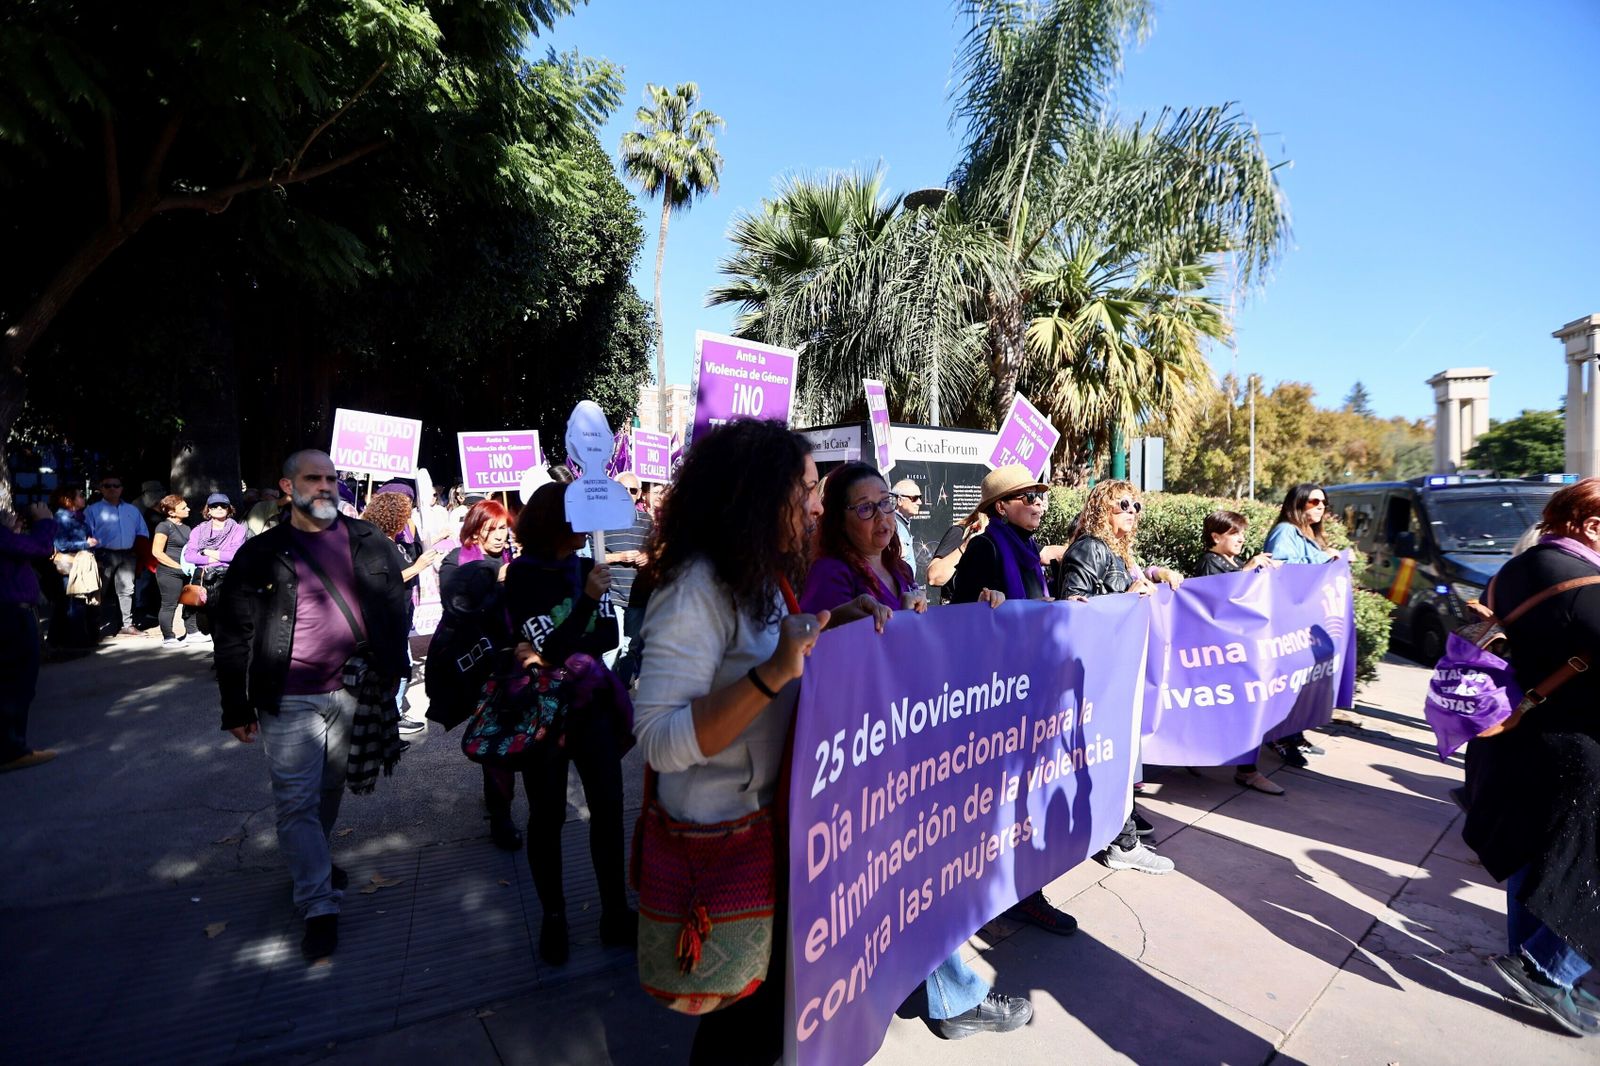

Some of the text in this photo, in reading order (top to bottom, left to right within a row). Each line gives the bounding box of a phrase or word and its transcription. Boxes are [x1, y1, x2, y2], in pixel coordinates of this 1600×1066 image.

[736, 349, 766, 365] Ante la
[705, 361, 789, 385] Violencia de Género
[341, 414, 414, 439] IGUALDAD
[364, 434, 388, 452] SIN
[904, 435, 978, 456] CaixaForum
[337, 447, 410, 472] VIOLENCIA
[476, 472, 489, 485] TE
[1178, 641, 1247, 669] una
[1161, 682, 1235, 710] ivas
[1289, 652, 1341, 693] quere
[811, 671, 1031, 800] 25 de Noviembre
[807, 697, 1094, 884] Día Internacional para la
[804, 732, 1115, 964] eliminación de la violencia
[796, 815, 1039, 1042] contra las mujeres.
